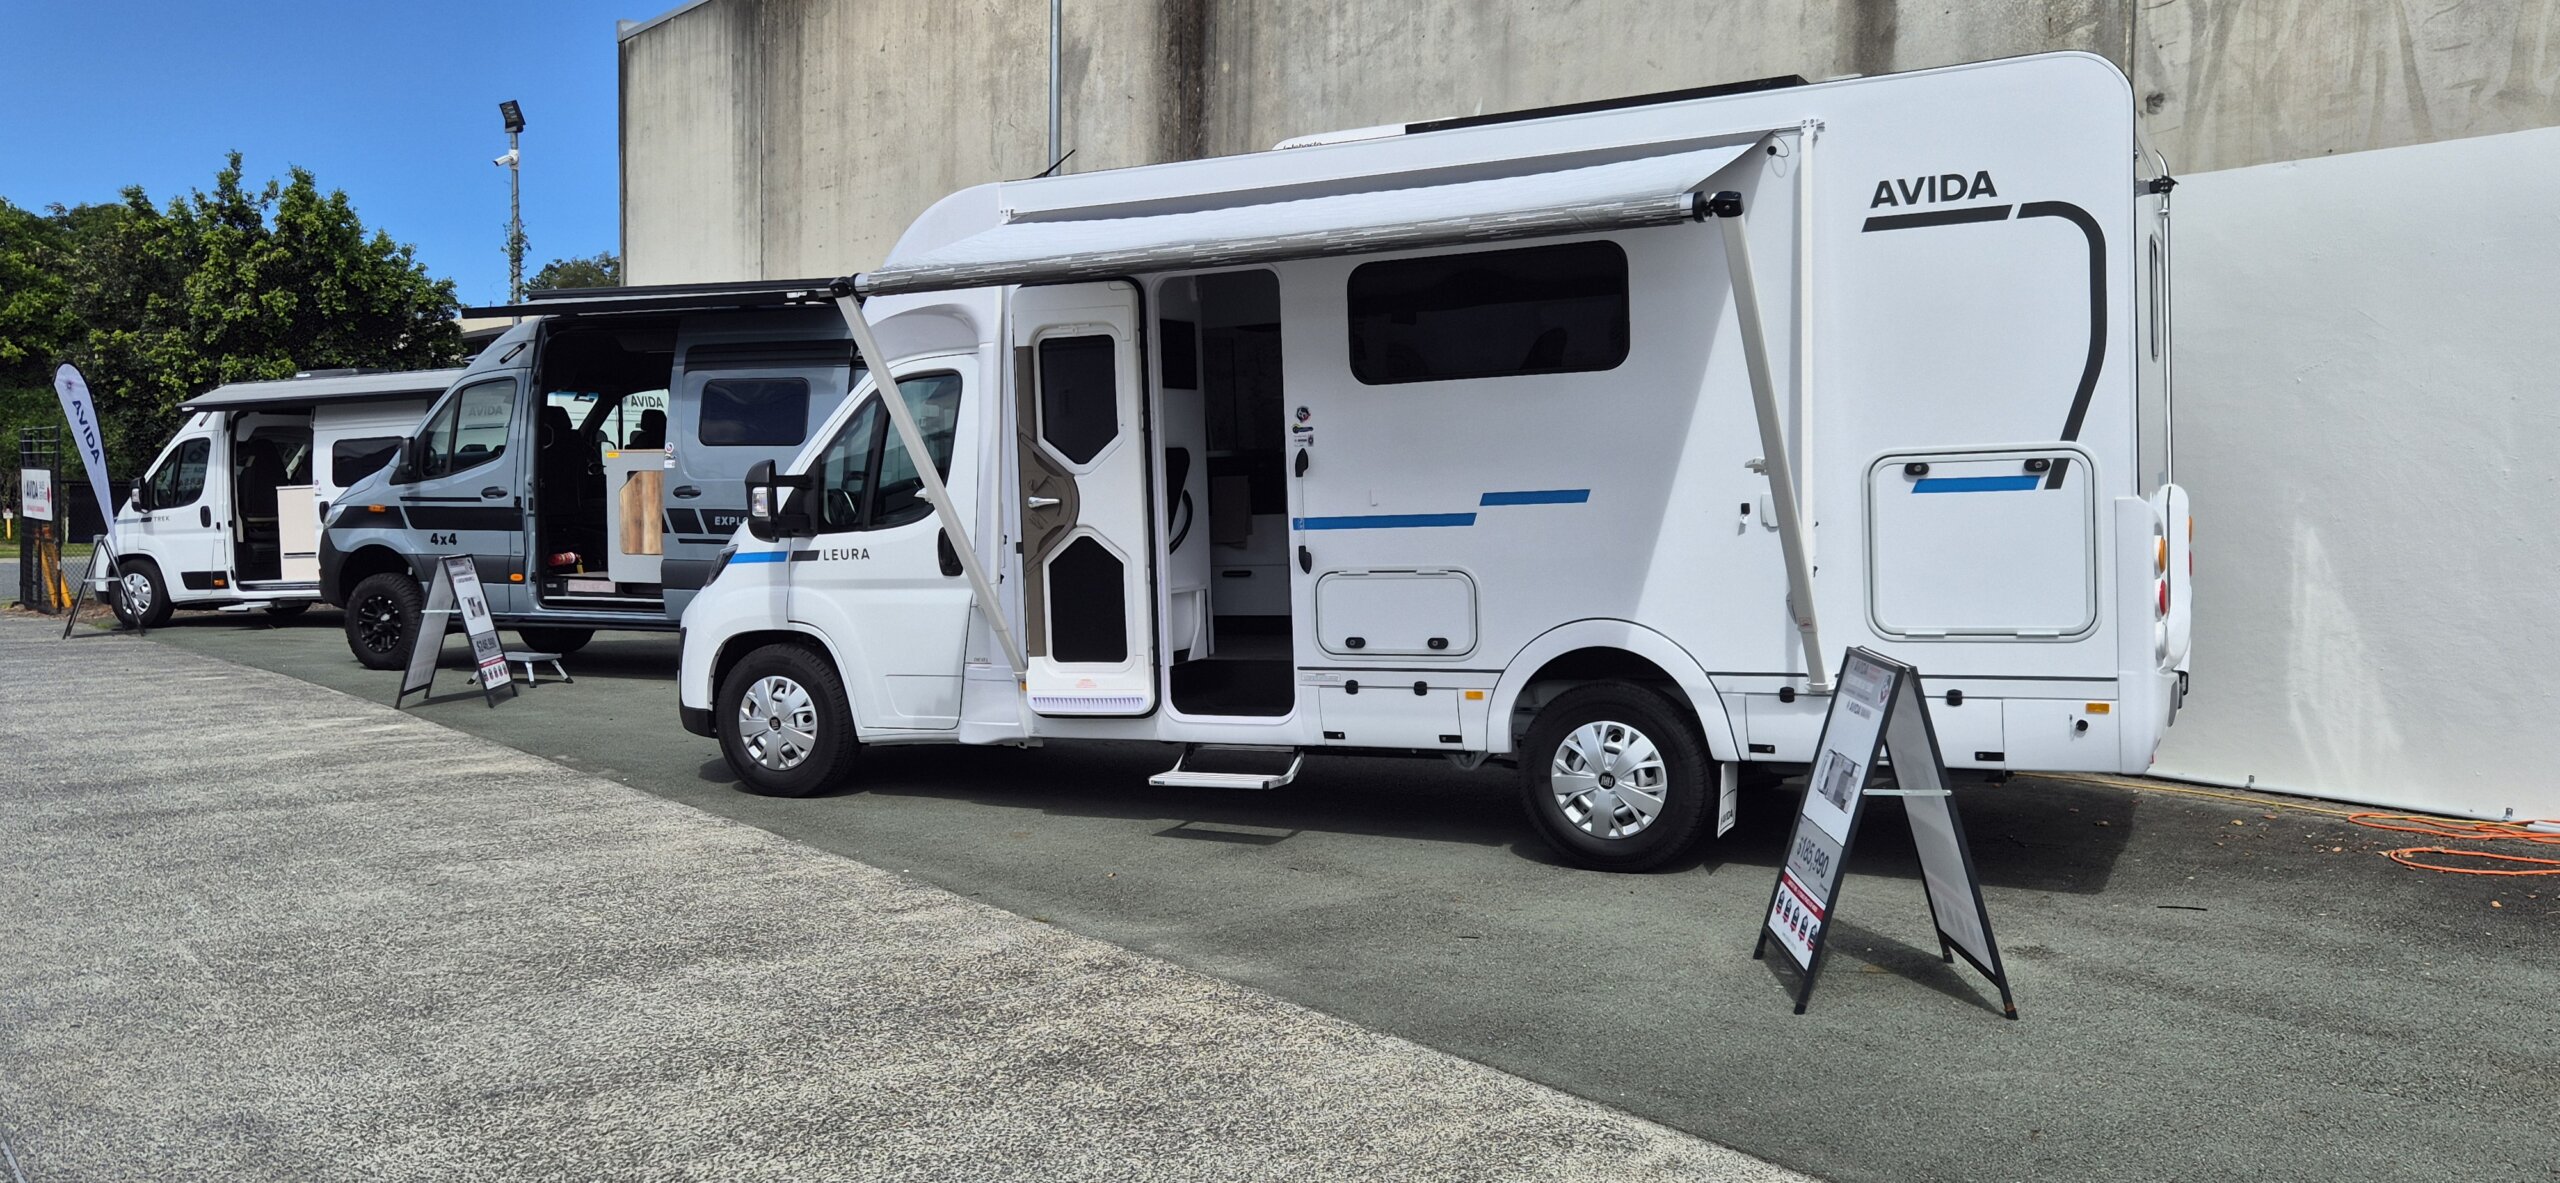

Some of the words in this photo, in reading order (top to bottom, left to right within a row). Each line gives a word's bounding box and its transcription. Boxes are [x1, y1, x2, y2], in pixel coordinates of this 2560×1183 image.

[1870, 170, 1997, 208] AVIDA
[631, 395, 664, 408] AVIDA
[468, 405, 503, 416] AVIDA
[72, 400, 100, 464] AVIDA
[430, 533, 457, 545] 4x4
[823, 548, 870, 561] LEURA
[1796, 836, 1829, 879] $185,990
